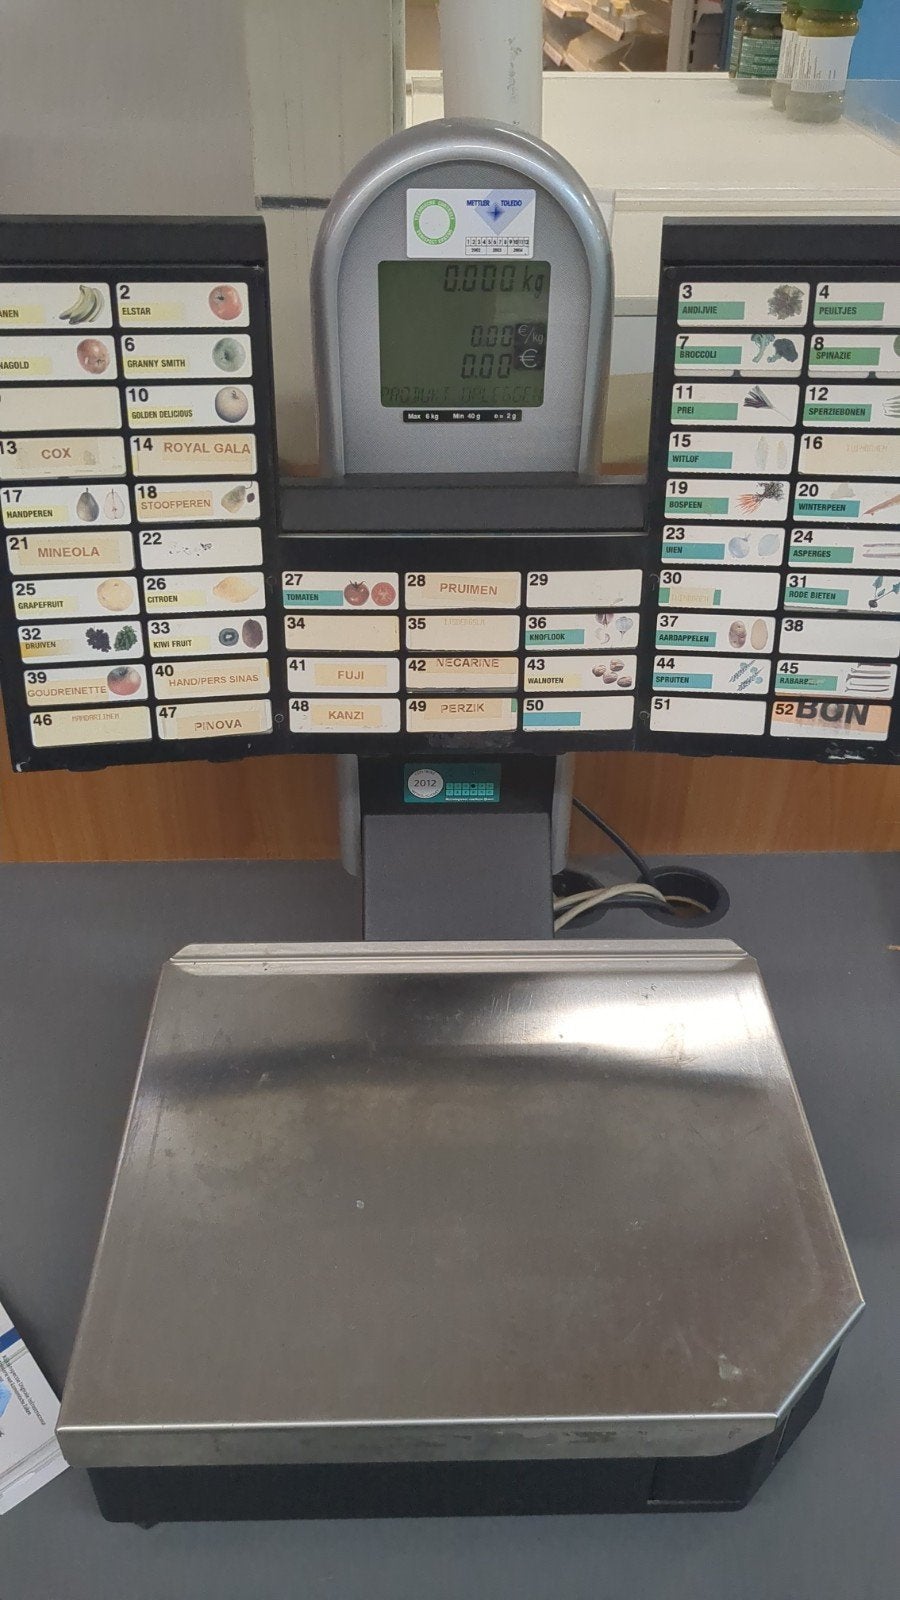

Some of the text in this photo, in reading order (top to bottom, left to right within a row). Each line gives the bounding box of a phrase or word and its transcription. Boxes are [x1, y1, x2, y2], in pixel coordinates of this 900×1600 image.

[444, 265, 544, 299] 0.000 kg
[119, 285, 131, 299] 2
[682, 285, 693, 299] 3
[819, 285, 830, 299] 4
[122, 307, 151, 316] ELSTAR
[682, 306, 718, 315] ANDIJVIE
[819, 306, 857, 315] PEULTJES
[471, 324, 544, 347] 0.00 €/kg
[124, 337, 135, 352] 6
[679, 335, 689, 349] 7
[814, 337, 824, 351] 8
[679, 350, 717, 359] BROCCOLI
[816, 351, 851, 360] SPINAZIE
[127, 359, 186, 368] GRANNY SMITH
[461, 349, 538, 379] 0.00 €
[128, 388, 149, 402] 10
[675, 386, 693, 399] 11
[809, 387, 828, 401] 12
[131, 409, 193, 420] GOLDEN DELICIOUS
[676, 406, 694, 415] PREI
[808, 408, 866, 417] SPERZIEBONEN
[431, 413, 439, 421] kg
[133, 437, 153, 452] 14
[672, 434, 691, 448] 15
[803, 436, 823, 449] 16
[0, 441, 17, 455] 13
[41, 447, 72, 460] COX
[164, 442, 251, 454] ROYAL GALA
[672, 455, 699, 463] WITLOF
[137, 486, 158, 499] 18
[669, 481, 688, 494] 19
[798, 484, 819, 497] 20
[3, 490, 23, 503] 17
[141, 499, 211, 510] STOOFPEREN
[669, 501, 703, 509] BOSPEEN
[798, 503, 846, 512] WINTERPEEN
[6, 509, 53, 518] HANDPEREN
[142, 532, 162, 545] 22
[665, 527, 685, 540] 23
[793, 530, 813, 543] 24
[10, 537, 29, 550] 21
[37, 546, 100, 558] MINEOLA
[665, 546, 683, 554] UIEN
[792, 549, 831, 558] ASPERGES
[146, 577, 166, 590] 26
[284, 573, 303, 586] 27
[407, 574, 426, 587] 28
[529, 573, 548, 586] 29
[662, 571, 682, 584] 30
[789, 576, 807, 588] 31
[15, 583, 36, 596] 25
[439, 582, 498, 596] PRUIMEN
[147, 595, 178, 604] CITROEN
[286, 593, 319, 601] TOMATEN
[788, 591, 836, 600] RODE BIETEN
[18, 600, 64, 610] GRAPEFRUIT
[287, 617, 305, 629] 34
[408, 618, 426, 630] 35
[528, 617, 547, 629] 36
[659, 615, 678, 627] 37
[784, 619, 804, 632] 38
[151, 621, 170, 634] 33
[21, 628, 41, 641] 32
[529, 633, 565, 641] KNOFLOOK
[659, 633, 709, 643] AARDAPPELEN
[25, 641, 56, 650] DRUIVEN
[153, 639, 192, 649] KIWI FRUIT
[289, 659, 306, 671] 41
[408, 660, 427, 671] 42
[436, 658, 499, 669] NECARINE
[527, 659, 546, 671] 43
[656, 657, 675, 669] 44
[779, 662, 799, 674] 45
[154, 664, 174, 677] 40
[337, 670, 364, 680] FUJI
[27, 672, 47, 684] 39
[168, 674, 259, 687] HAND/PERS SINAS
[527, 677, 564, 685] WALNOTEN
[655, 676, 689, 684] SPRUITEN
[27, 686, 107, 698] GOUDREINETTE
[291, 700, 309, 712] 48
[408, 700, 427, 712] 49
[440, 702, 484, 713] PERZIK
[526, 699, 544, 711] 50
[654, 698, 671, 710] 51
[159, 706, 177, 719] 47
[328, 710, 364, 720] KANZI
[775, 701, 869, 726] 52 BON
[32, 714, 53, 726] 46
[194, 719, 242, 731] PINOVA
[414, 779, 437, 787] 2012
